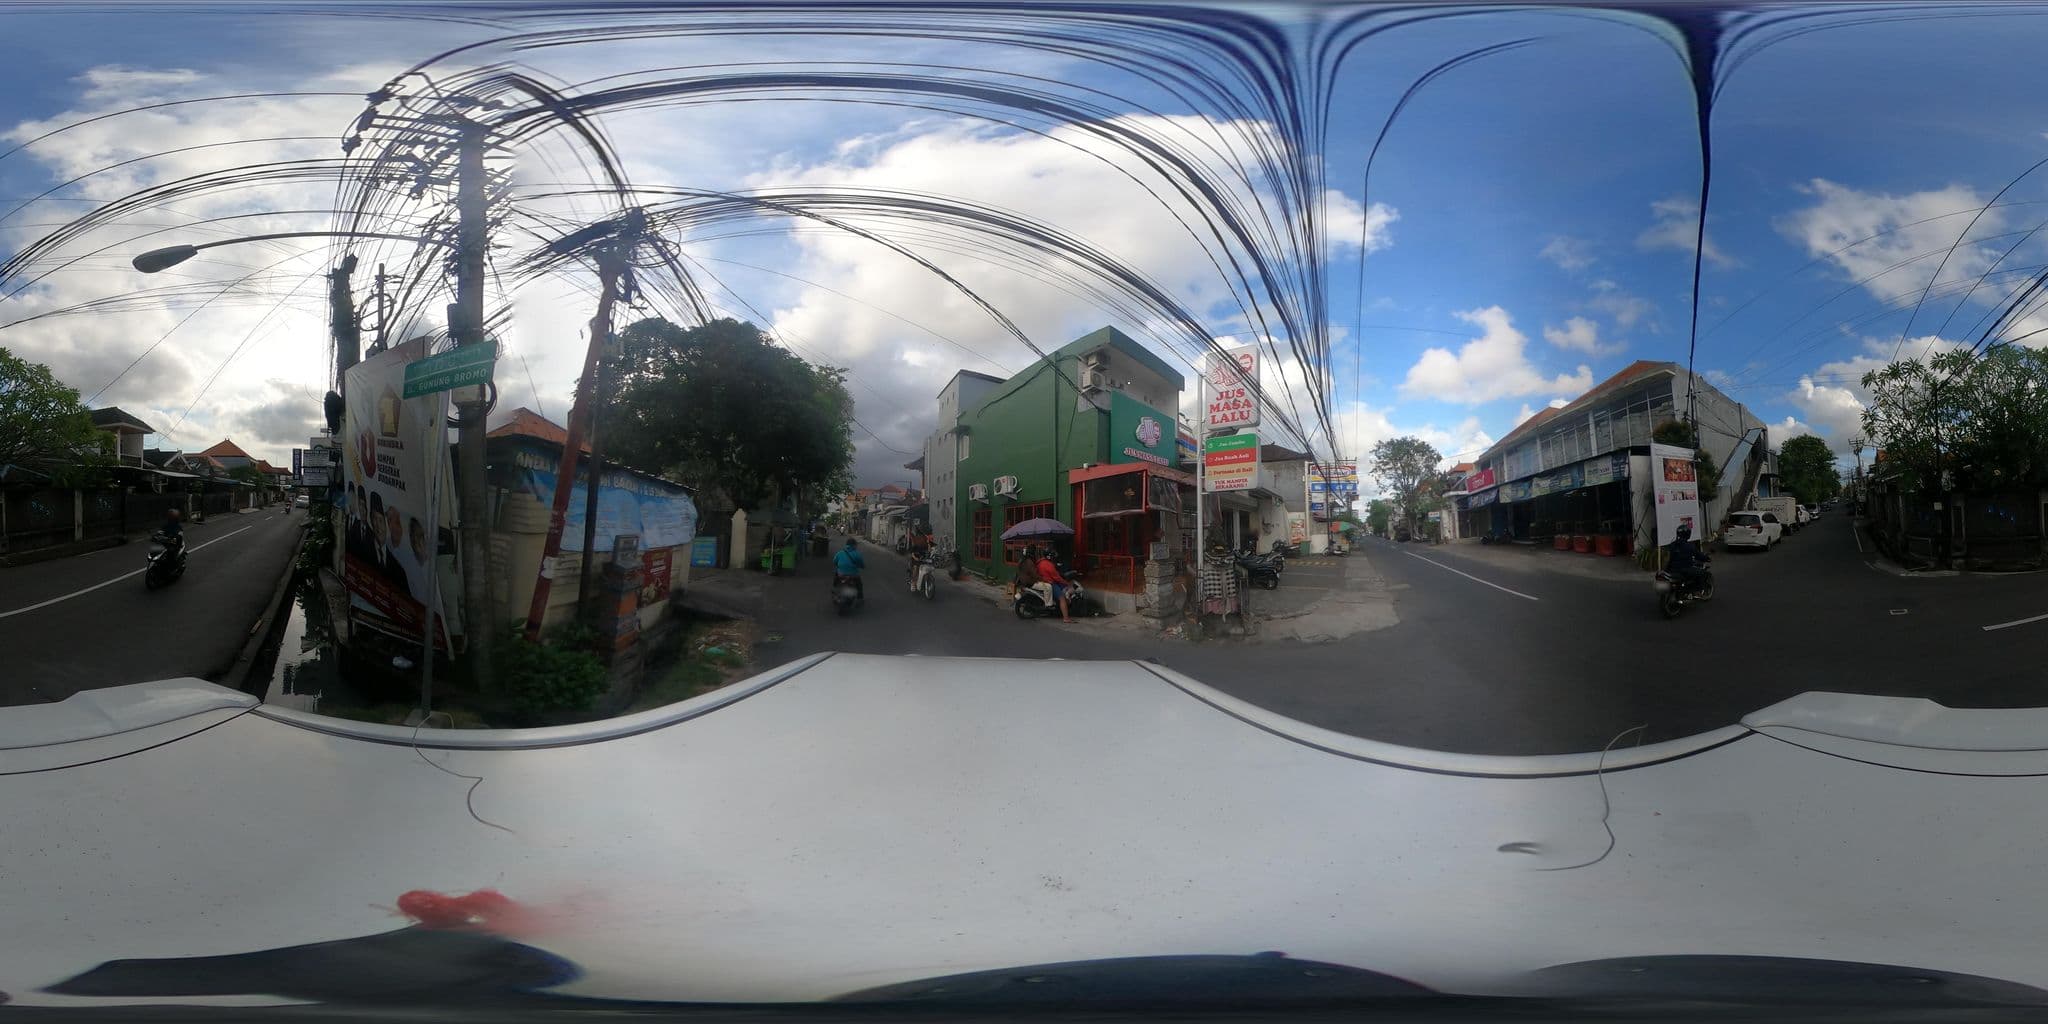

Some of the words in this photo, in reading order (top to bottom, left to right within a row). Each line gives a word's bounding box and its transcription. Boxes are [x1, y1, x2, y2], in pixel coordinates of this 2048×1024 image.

[419, 376, 450, 391] GUNUNG
[455, 368, 487, 383] BROMO
[1216, 388, 1245, 400] JUS
[1209, 399, 1252, 413] MASA
[1211, 410, 1250, 424] LALU
